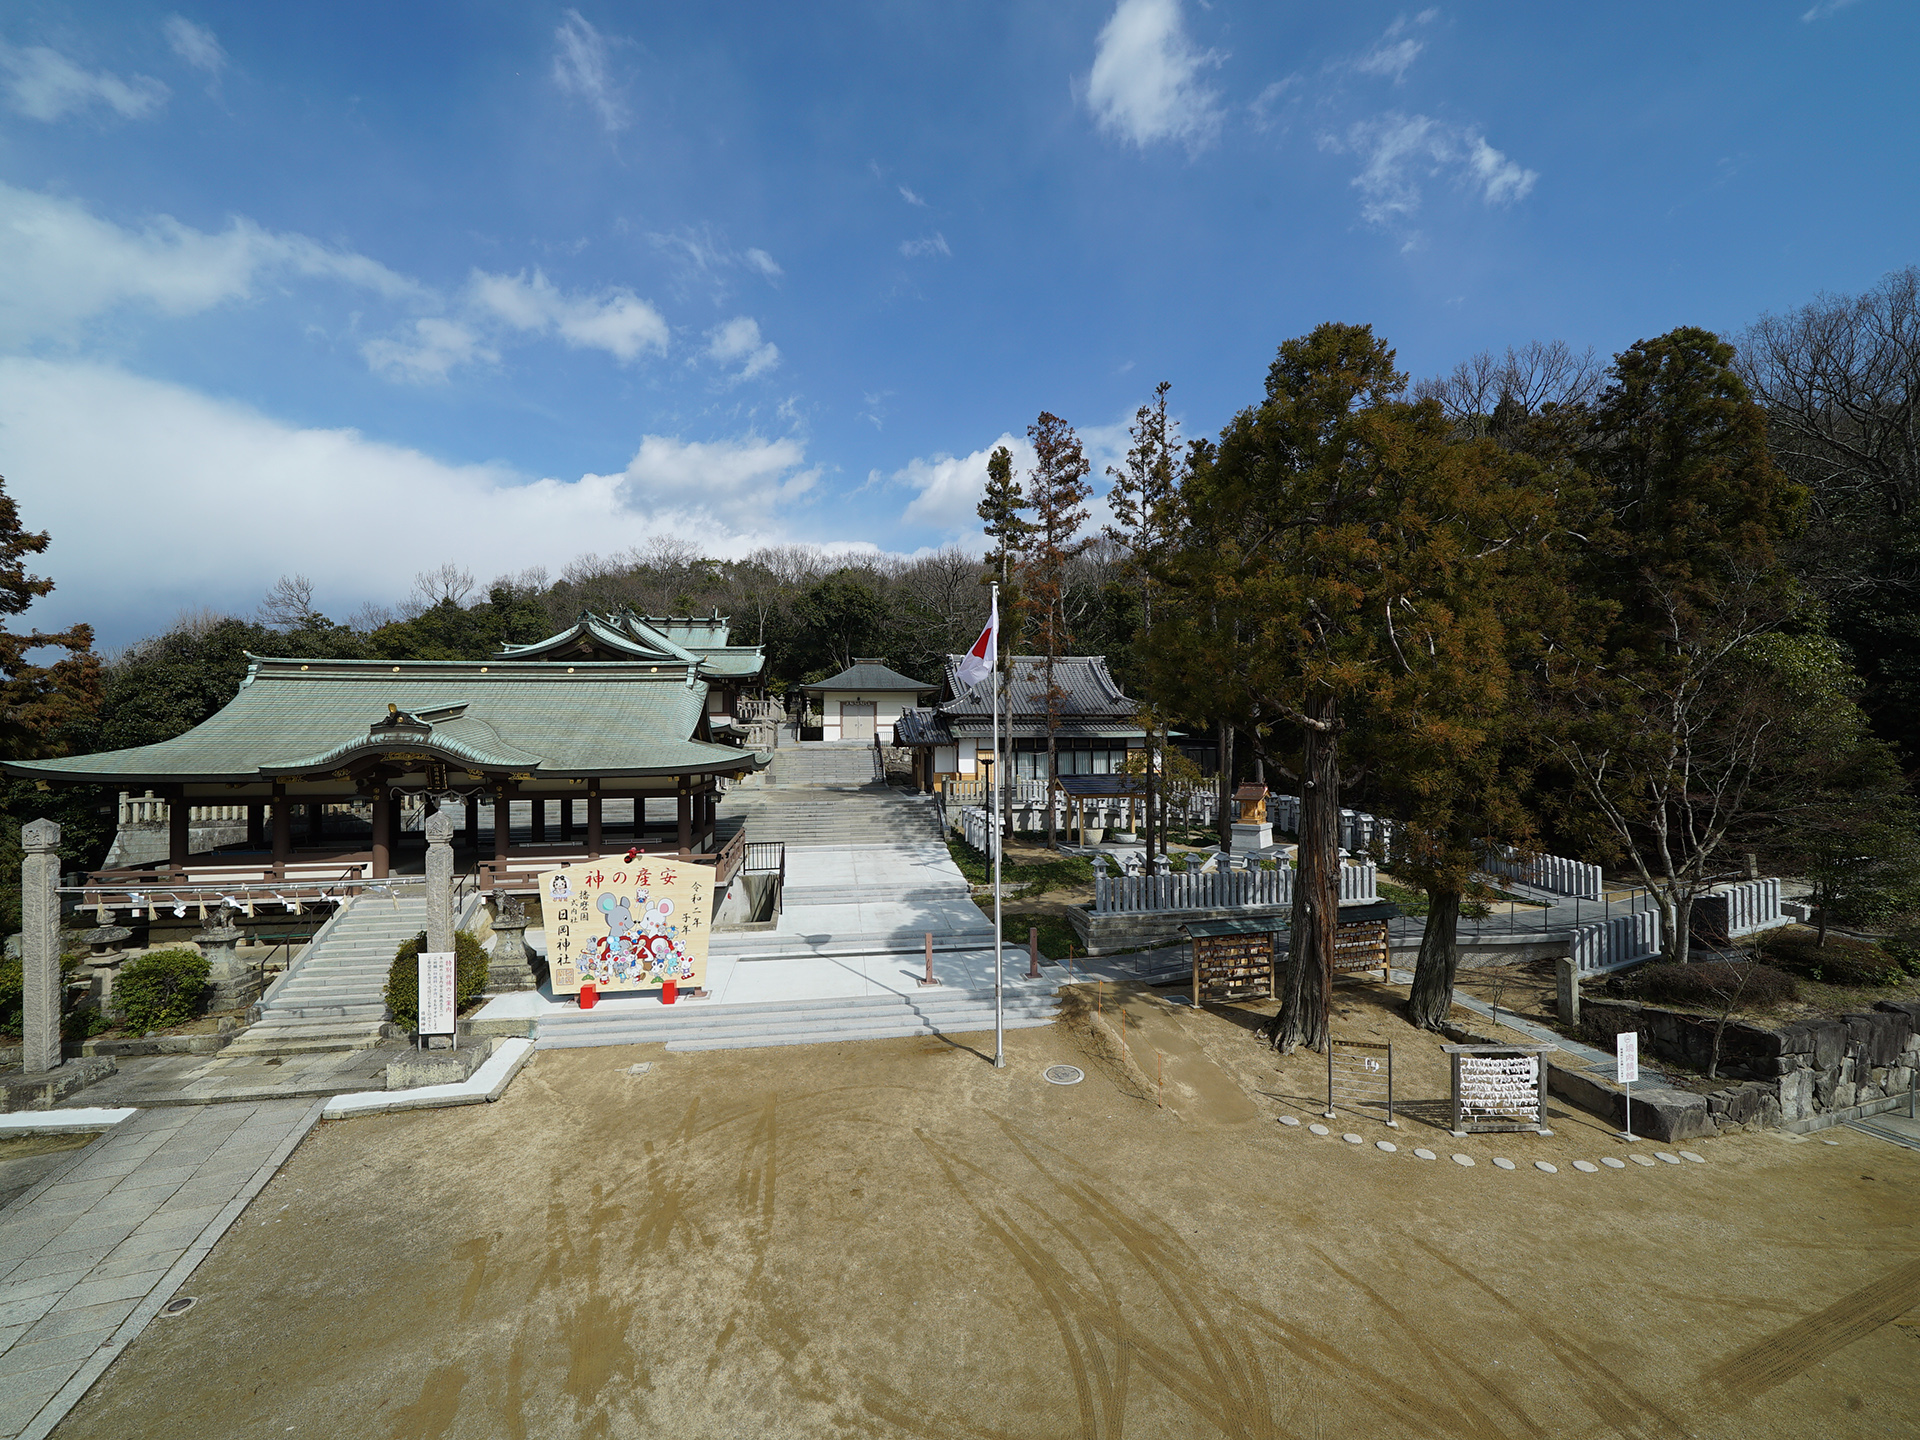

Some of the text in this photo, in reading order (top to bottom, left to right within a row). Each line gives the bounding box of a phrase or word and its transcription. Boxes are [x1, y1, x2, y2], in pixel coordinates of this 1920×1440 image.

[681, 912, 691, 935] 子年
[691, 881, 702, 928] 令和二年
[556, 908, 571, 966] 日岡神社
